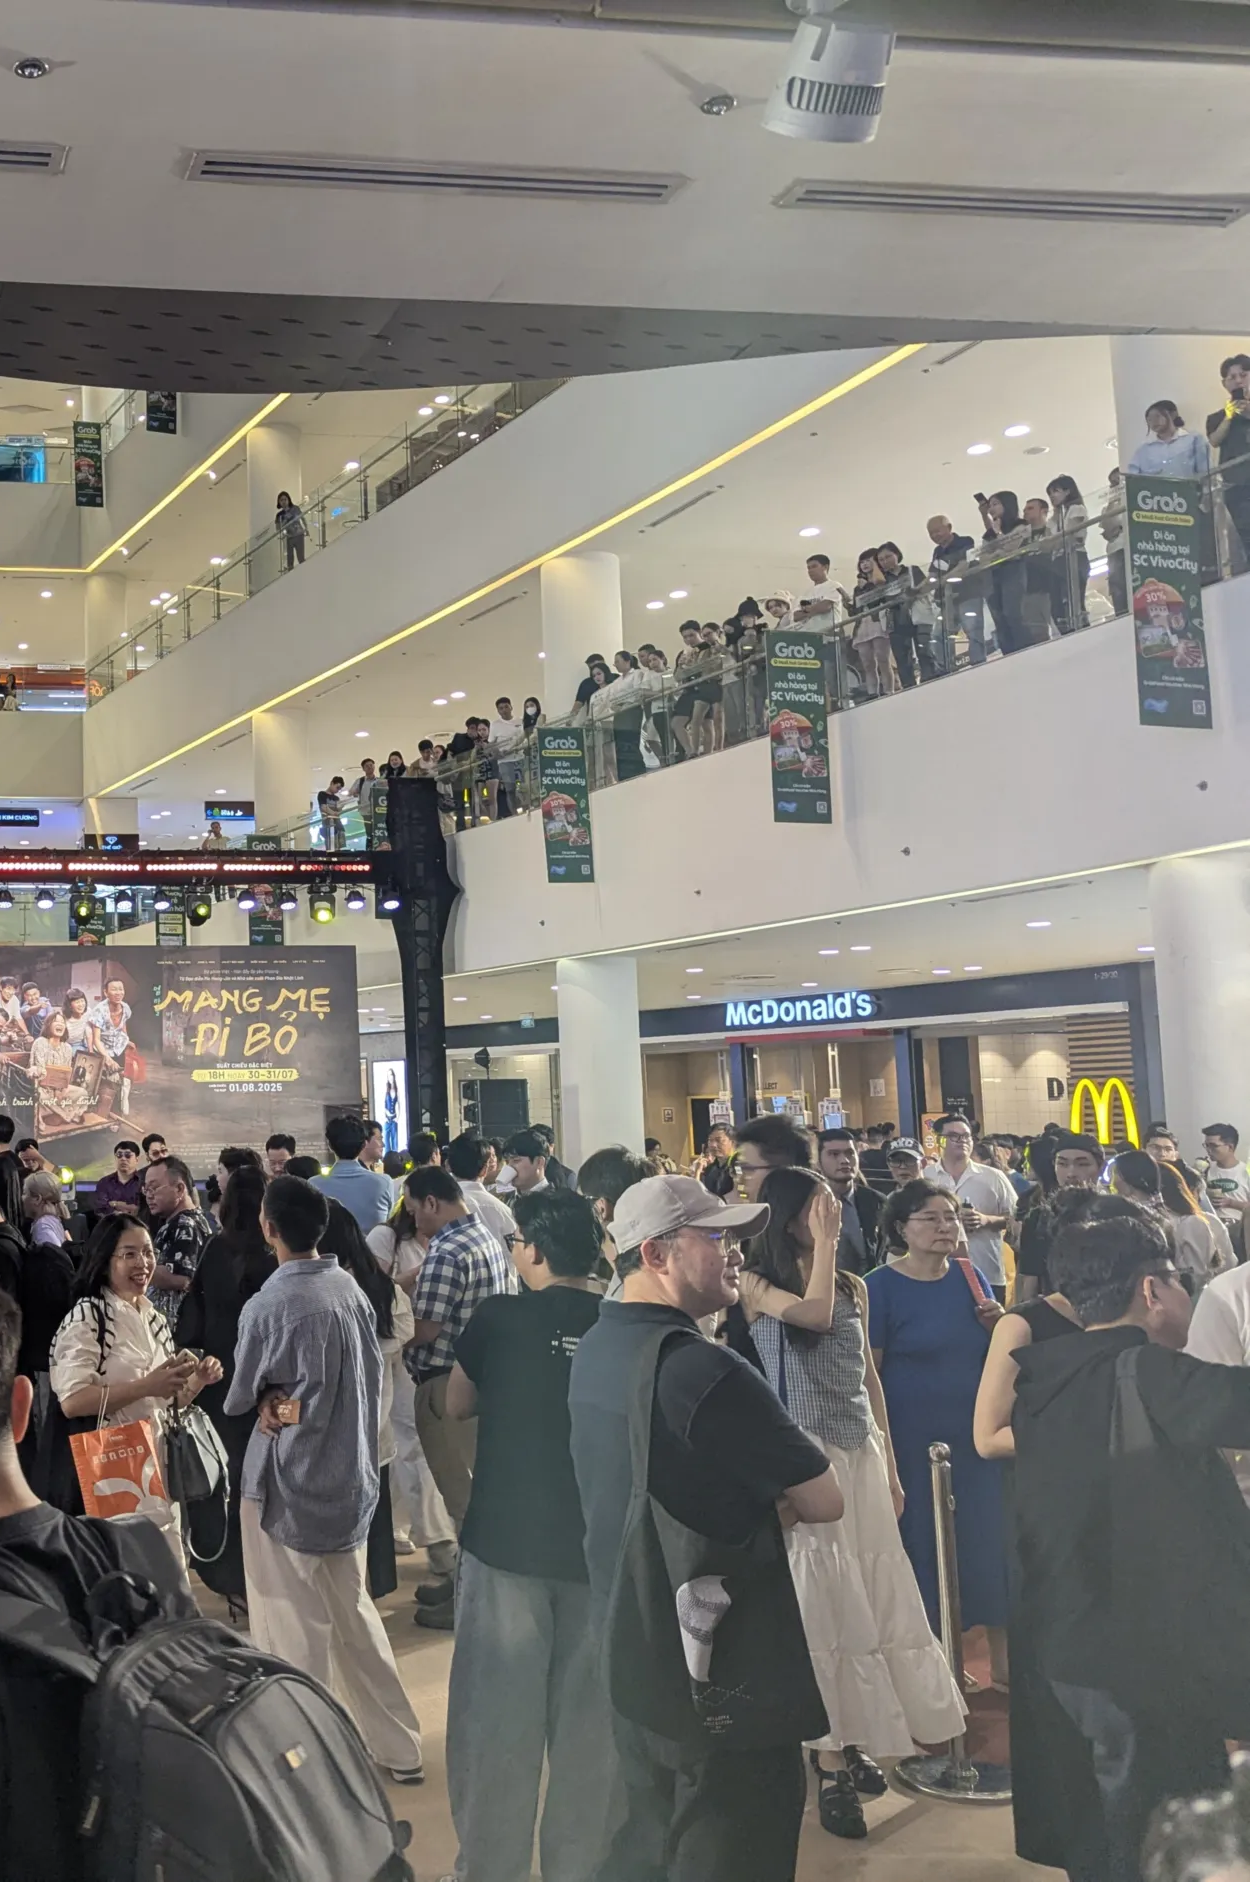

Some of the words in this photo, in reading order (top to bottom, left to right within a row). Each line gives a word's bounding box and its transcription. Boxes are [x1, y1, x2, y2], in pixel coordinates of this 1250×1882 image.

[77, 426, 98, 434] Grab
[1137, 490, 1187, 513] Grab
[1153, 530, 1162, 540] Đi
[1137, 540, 1154, 551] nhà
[1155, 541, 1177, 555] hàng
[1178, 545, 1190, 555] tại
[1133, 554, 1148, 566] SC
[1149, 555, 1198, 574] VivoCity
[1145, 591, 1167, 602] 30%
[775, 642, 815, 658] Grab
[787, 672, 795, 680] Đi
[774, 681, 788, 689] nhà
[790, 682, 807, 691] hàng
[771, 691, 784, 700] SC
[785, 692, 825, 705] VivoCity
[780, 719, 798, 729] 30%
[544, 736, 577, 749] Grab
[542, 776, 552, 784] SC
[553, 776, 586, 786] VivoCity
[252, 841, 277, 850] Grab
[154, 989, 263, 1014] MANG
[266, 987, 331, 1020] MẸ
[725, 991, 872, 1026] McDonald's
[243, 1011, 298, 1056] BỎ
[208, 1070, 225, 1080] 18H
[248, 1069, 294, 1080] 30-31/07
[229, 1083, 283, 1093] 01.08.2025
